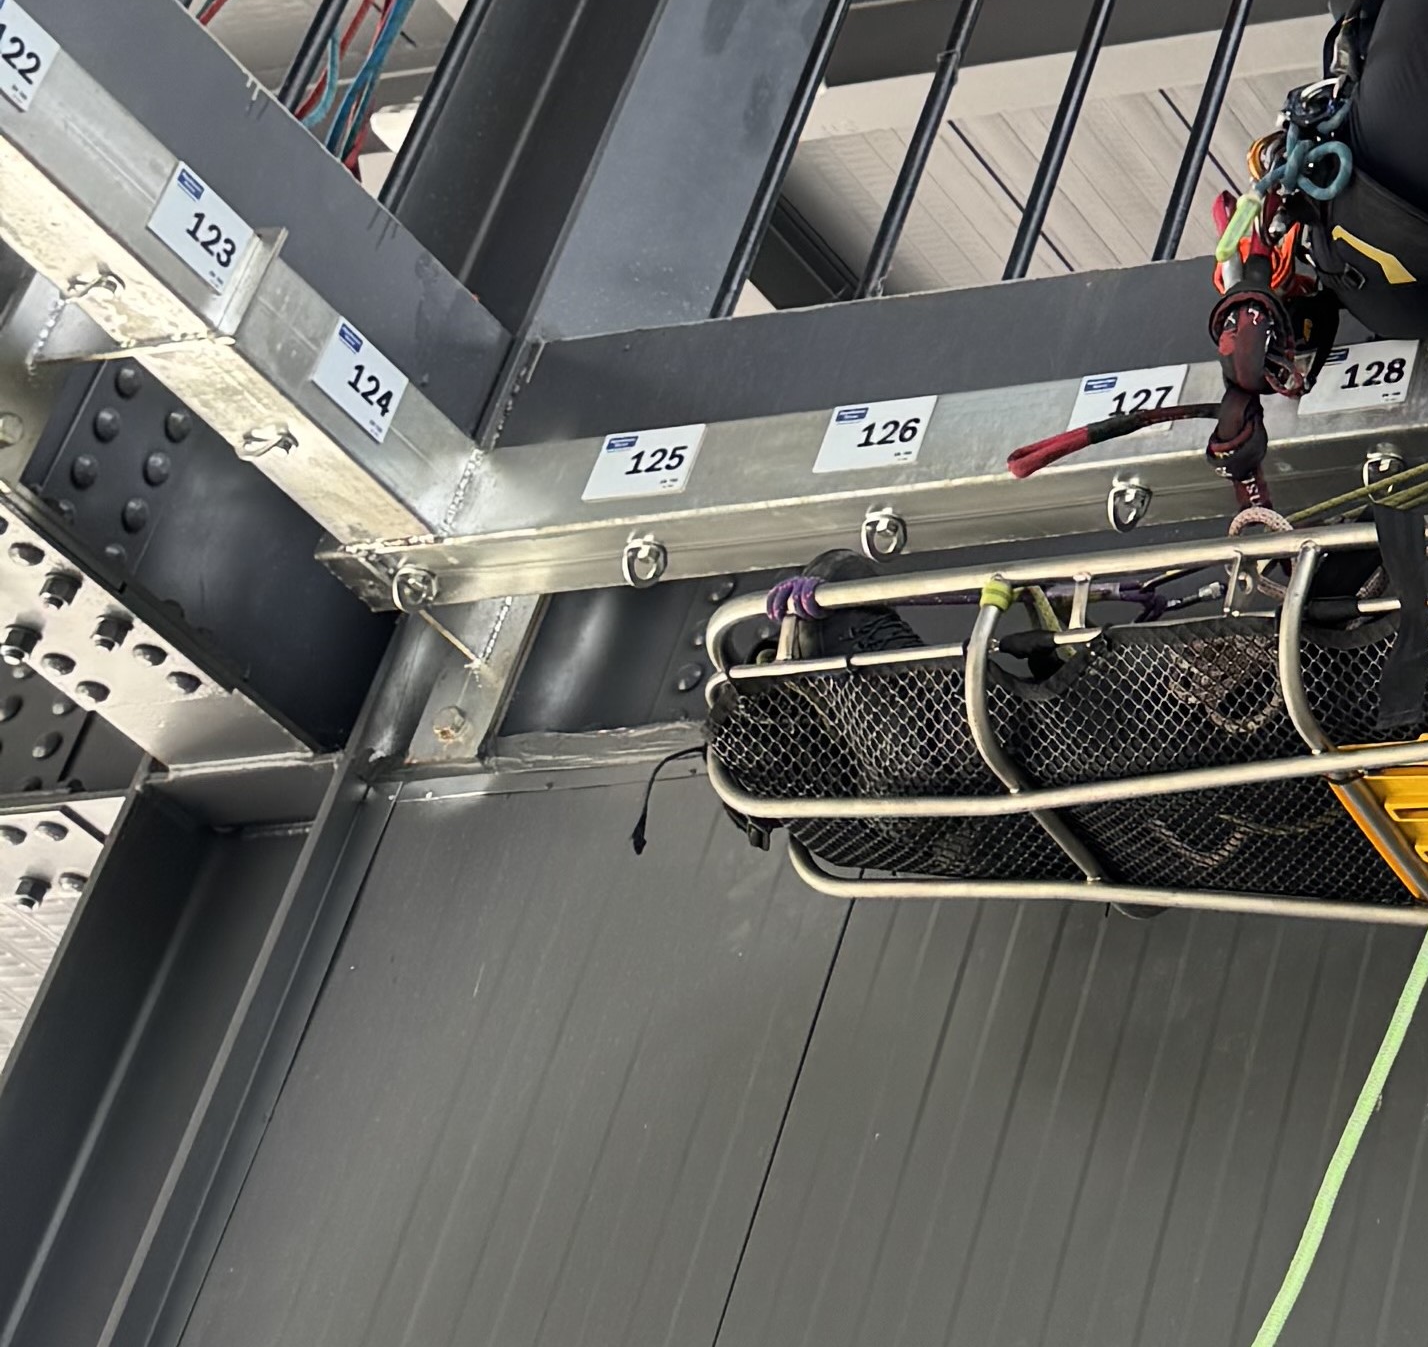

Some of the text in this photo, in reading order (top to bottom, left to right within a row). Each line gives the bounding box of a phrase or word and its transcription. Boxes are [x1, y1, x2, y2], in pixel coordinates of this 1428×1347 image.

[186, 212, 237, 268] 123
[1340, 357, 1408, 390] 128
[347, 364, 394, 418] 124
[1108, 385, 1175, 418] 127
[856, 417, 921, 448] 126
[625, 445, 689, 476] 125
